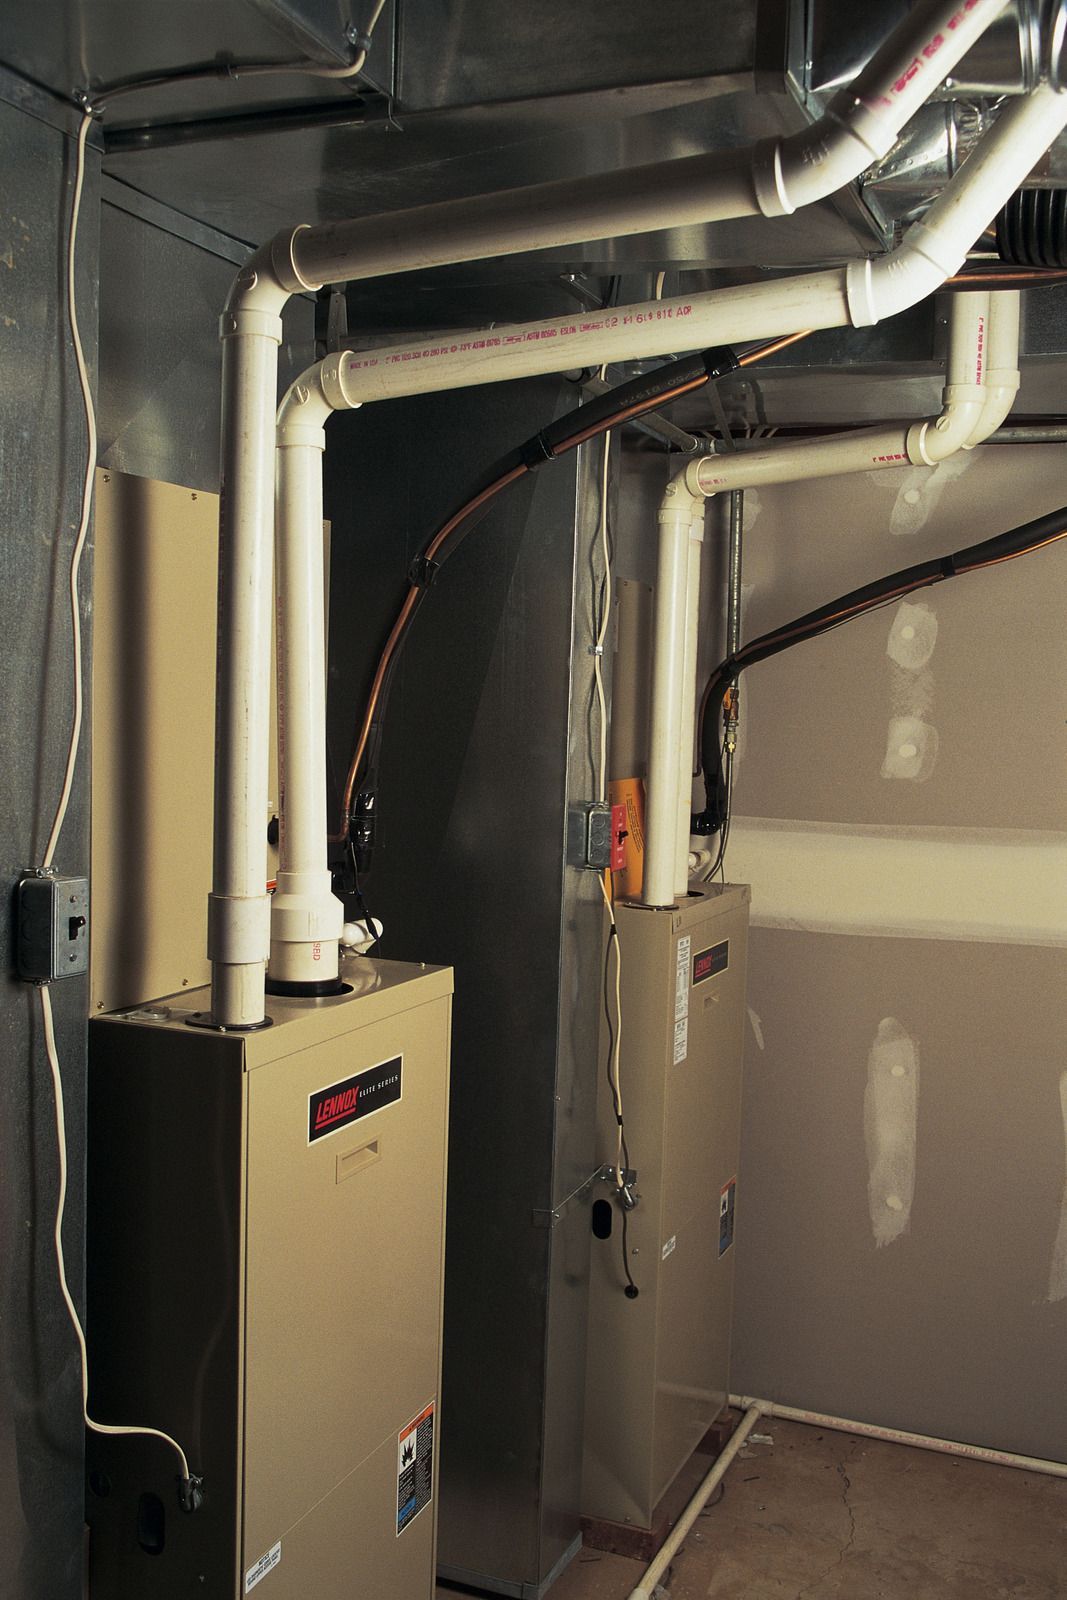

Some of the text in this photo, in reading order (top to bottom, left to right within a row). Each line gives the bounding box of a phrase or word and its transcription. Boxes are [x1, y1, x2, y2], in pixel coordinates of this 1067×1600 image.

[315, 1074, 399, 1124] LENNOX ELITE SERIES
